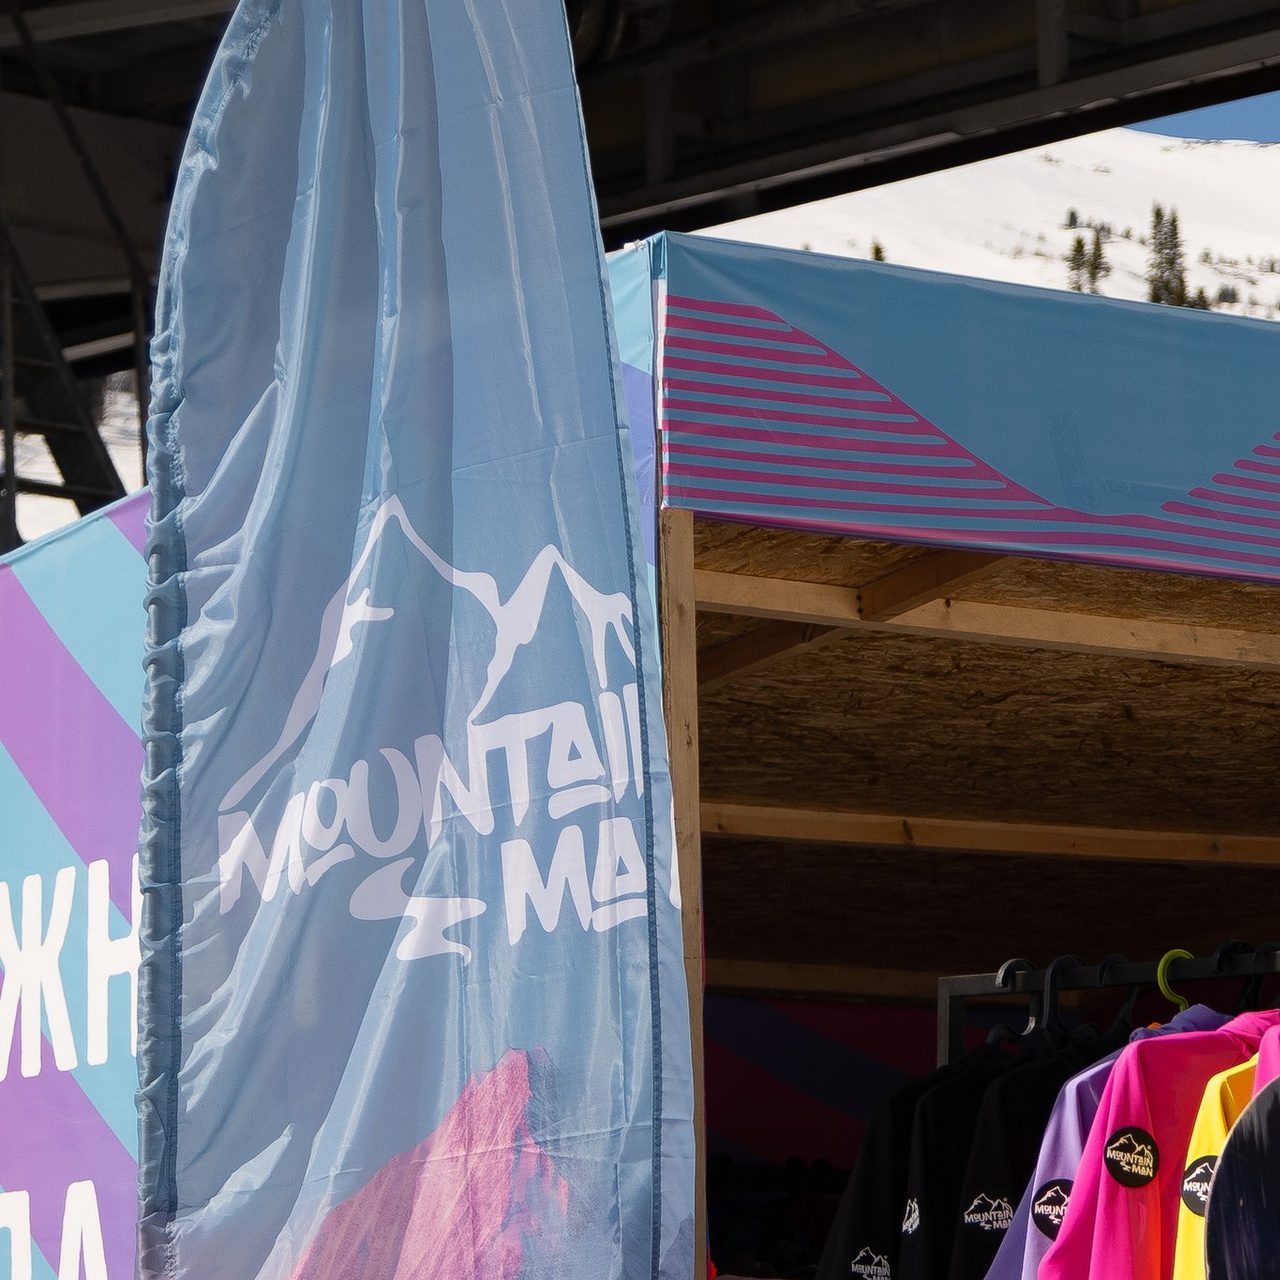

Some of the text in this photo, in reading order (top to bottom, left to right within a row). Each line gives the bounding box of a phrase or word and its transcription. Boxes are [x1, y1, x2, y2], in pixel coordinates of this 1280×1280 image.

[501, 816, 682, 945] MA
[1107, 1150, 1153, 1168] MOUNTAIN
[1132, 1165, 1153, 1177] MAN
[964, 1209, 1013, 1223] MOUNTAIN
[851, 1263, 891, 1277] MOUNTAIN
